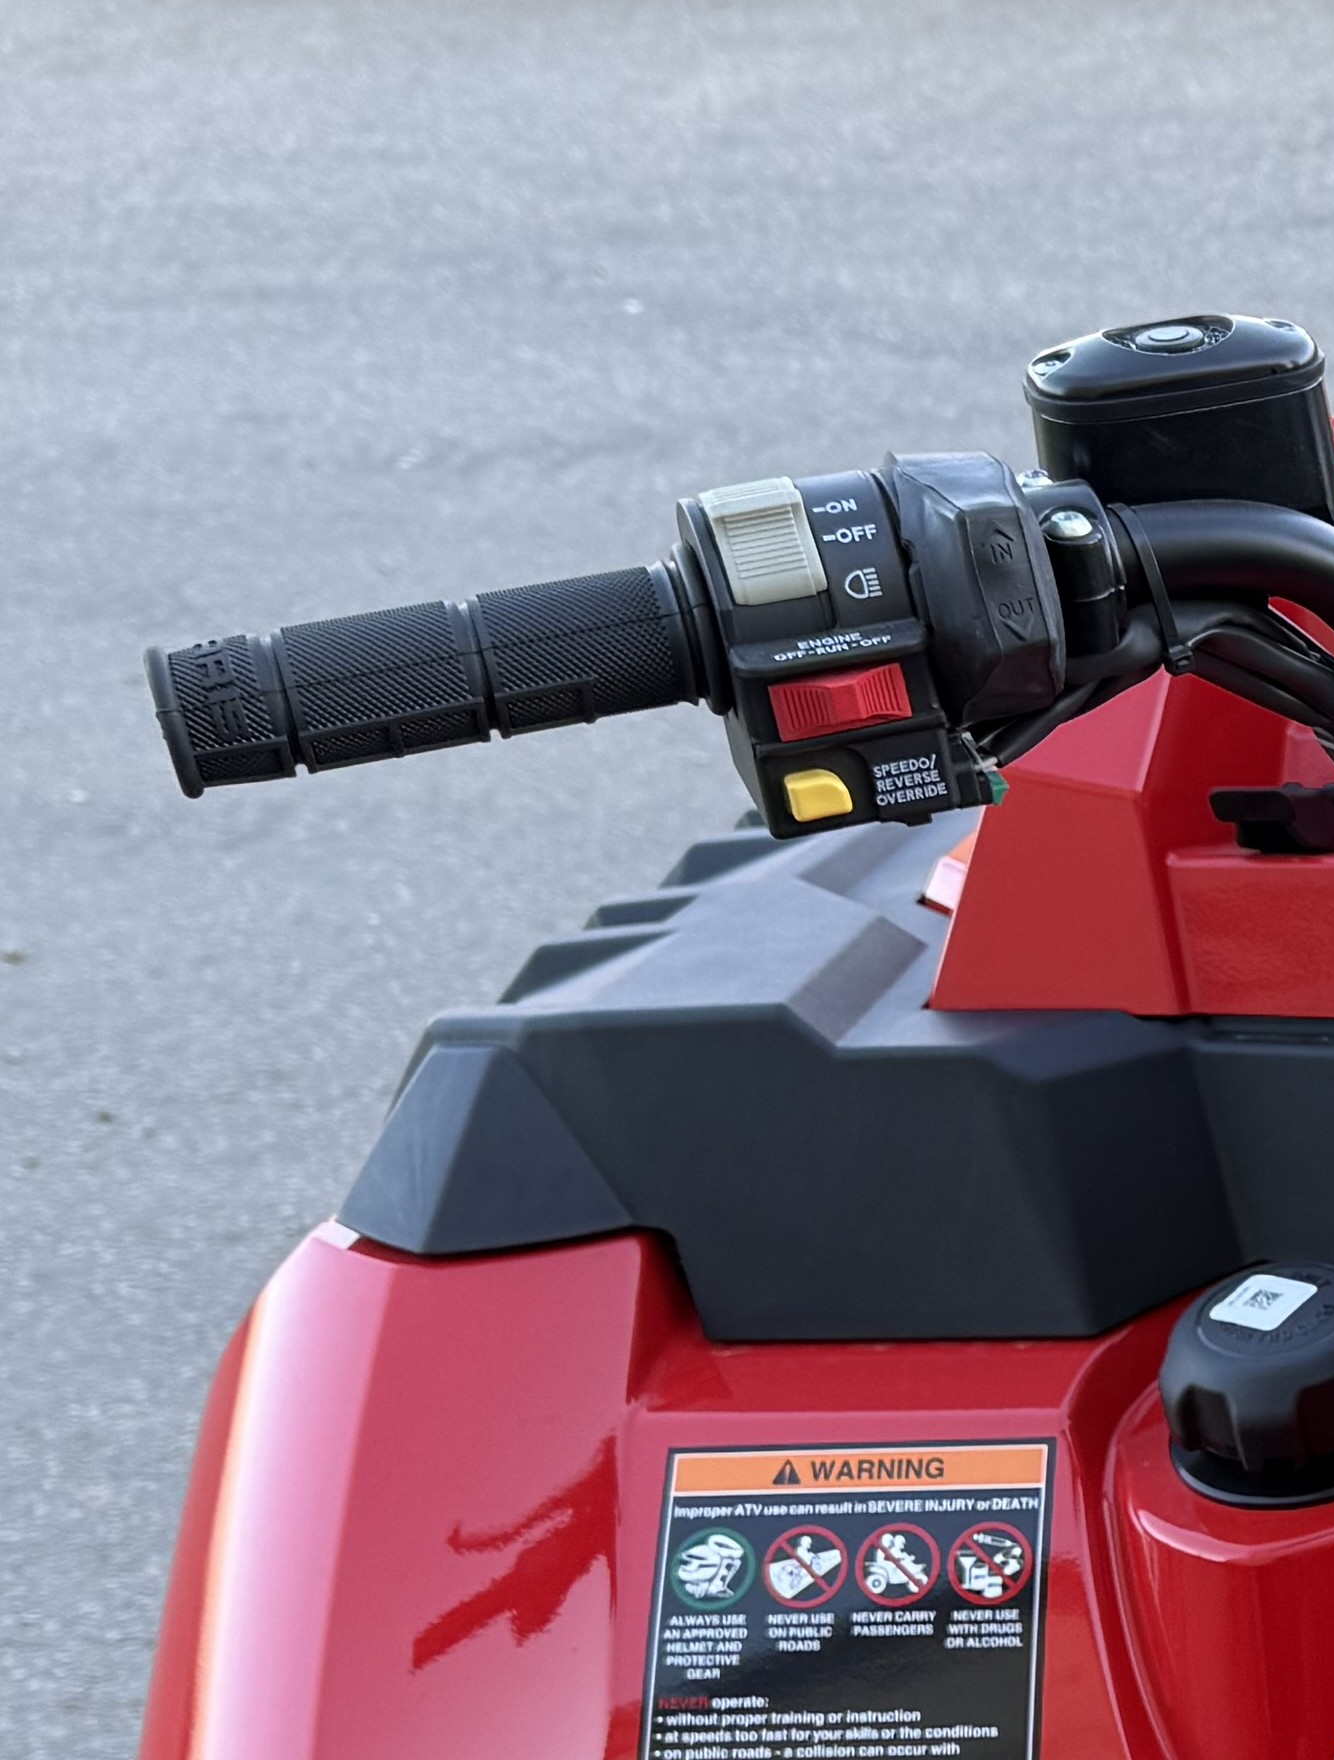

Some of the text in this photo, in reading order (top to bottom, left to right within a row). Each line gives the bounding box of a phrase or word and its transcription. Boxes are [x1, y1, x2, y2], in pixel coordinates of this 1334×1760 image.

[990, 542, 1014, 562] IN
[999, 598, 1034, 618] OUT
[798, 633, 862, 649] ENGINE
[874, 754, 936, 777] SPEEDO/
[877, 770, 940, 791] REVERSE
[876, 782, 947, 806] OVERRIDE
[811, 1457, 944, 1482] WARNING
[675, 1497, 1039, 1519] Improper ATV use can result in SEVERE INJURY or DEATH
[670, 1615, 746, 1626] ALWAYS USE
[768, 1614, 834, 1625] NEVER USE
[853, 1611, 936, 1622] NEVER CARRY
[953, 1609, 1019, 1621] NEVER USE
[664, 1628, 747, 1639] AN APPROVED
[769, 1627, 832, 1638] ON PUBLIC
[854, 1624, 933, 1636] PASSENGERS
[949, 1623, 1023, 1634] WITH DRUGS
[667, 1641, 742, 1653] HELMET AND
[779, 1641, 820, 1651] ROADS
[945, 1637, 1022, 1648] OR ALCOHOL
[666, 1655, 740, 1666] PROTECTIVE
[687, 1669, 720, 1679] GEAR
[666, 1709, 920, 1727] without proper training or instruction
[665, 1725, 998, 1744] at speeds too fast for your skills or the conditions
[664, 1749, 681, 1759] on
[686, 1747, 728, 1760] public
[732, 1746, 771, 1758] roads
[784, 1748, 792, 1758] a
[796, 1744, 855, 1758] collision
[859, 1745, 883, 1756] can
[888, 1744, 928, 1755] occur
[931, 1742, 960, 1755] with
